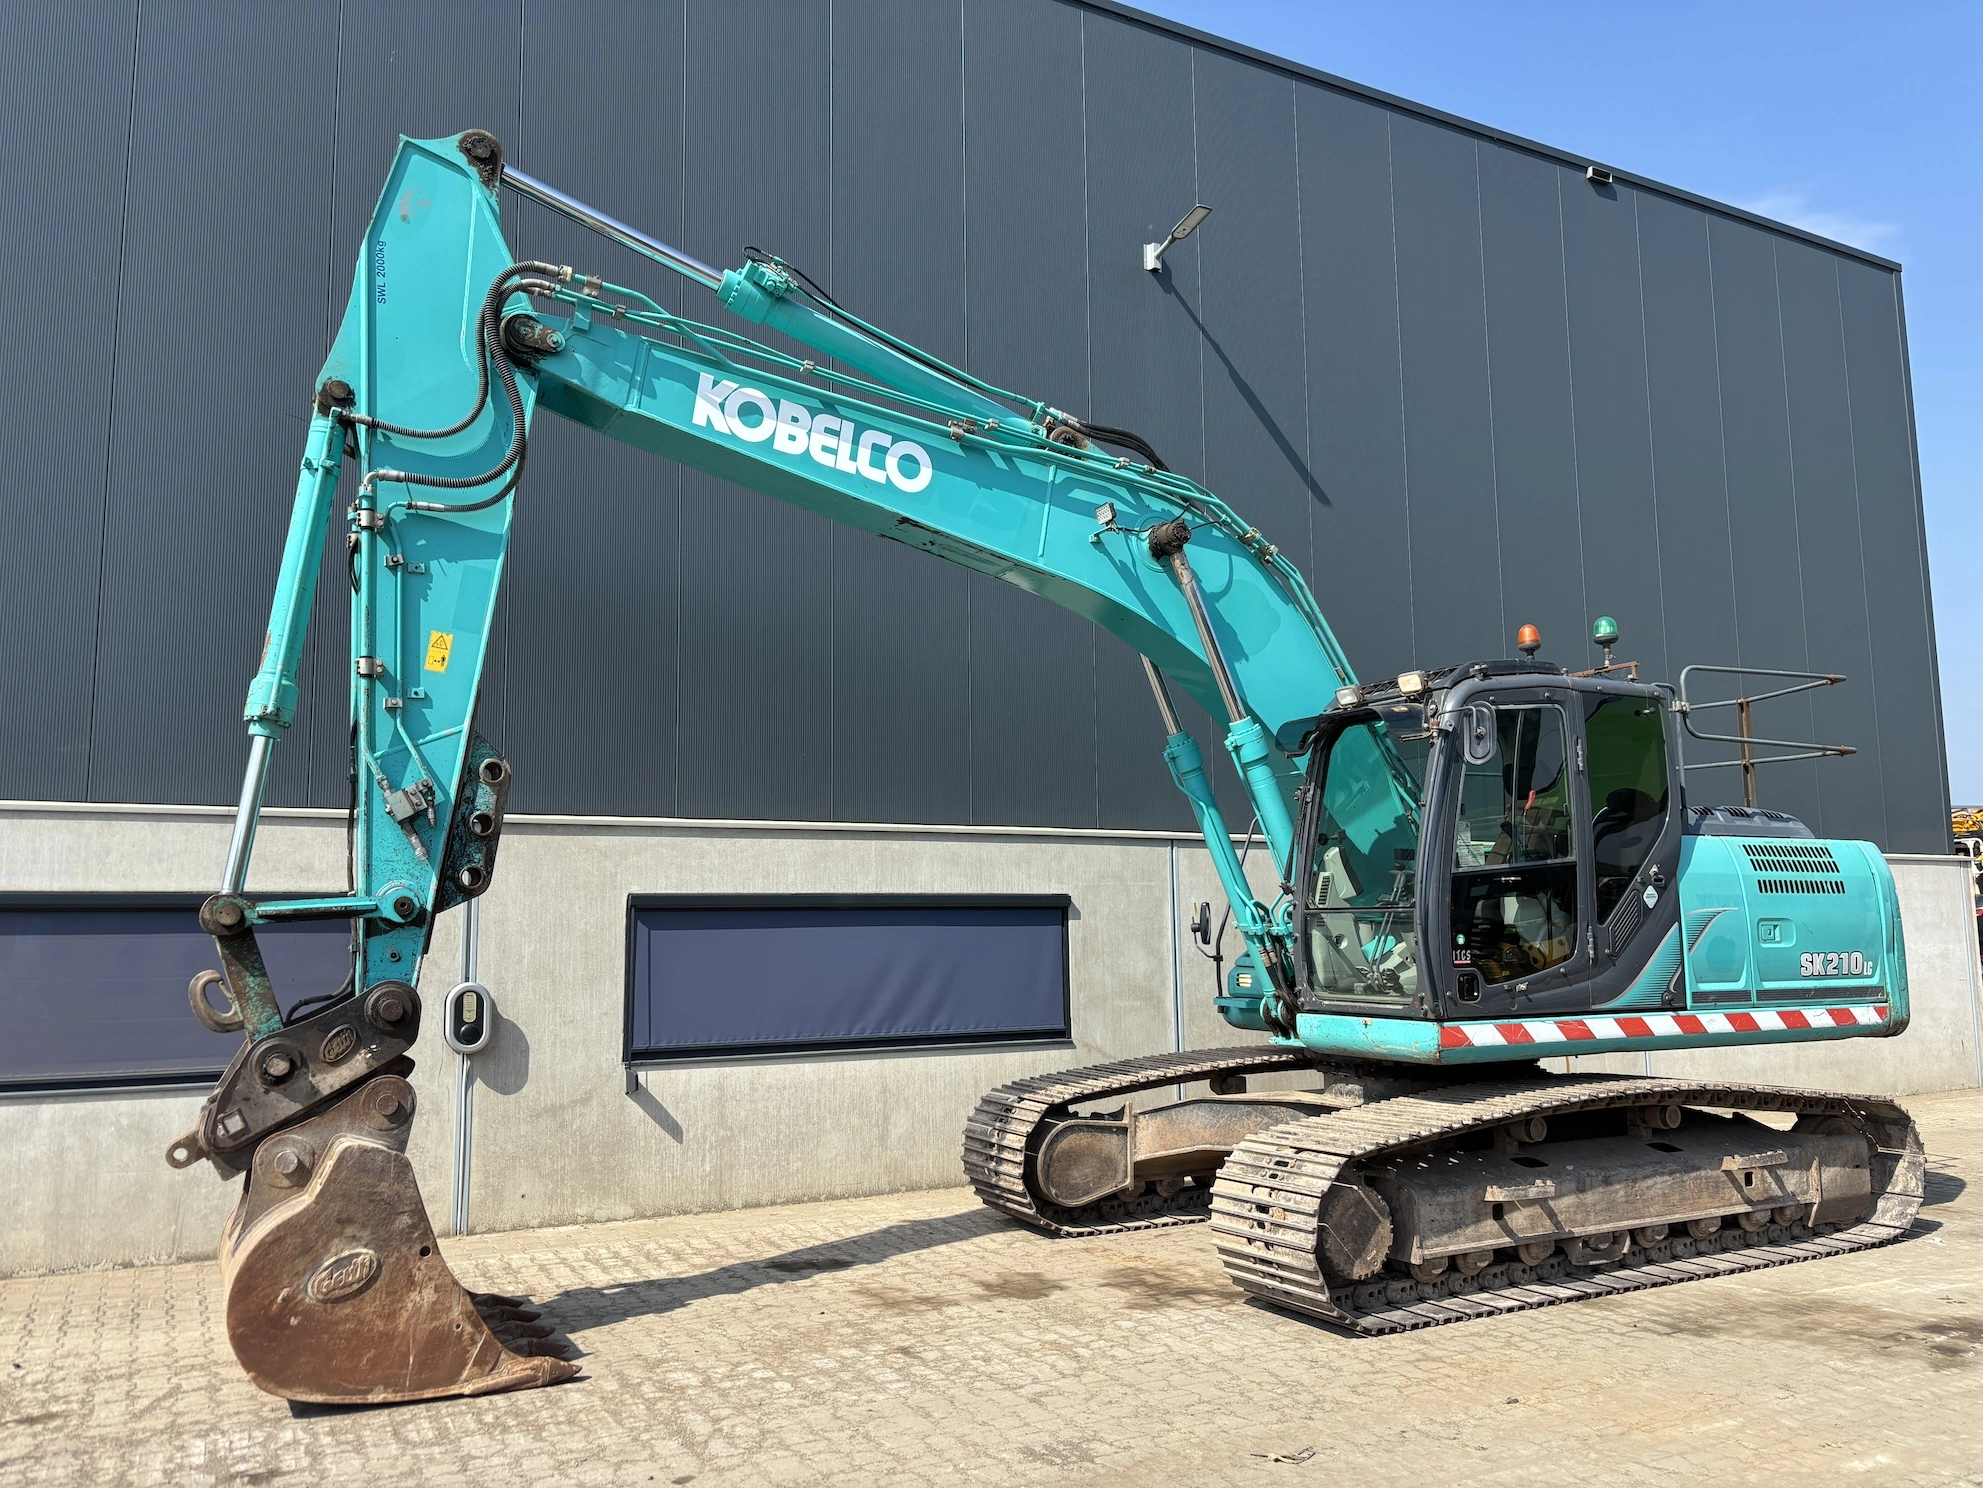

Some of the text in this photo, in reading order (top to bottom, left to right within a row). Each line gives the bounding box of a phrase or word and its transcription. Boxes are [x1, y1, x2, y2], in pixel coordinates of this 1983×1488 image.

[375, 240, 387, 305] SWL 2000kg
[692, 371, 933, 493] KOBELCO
